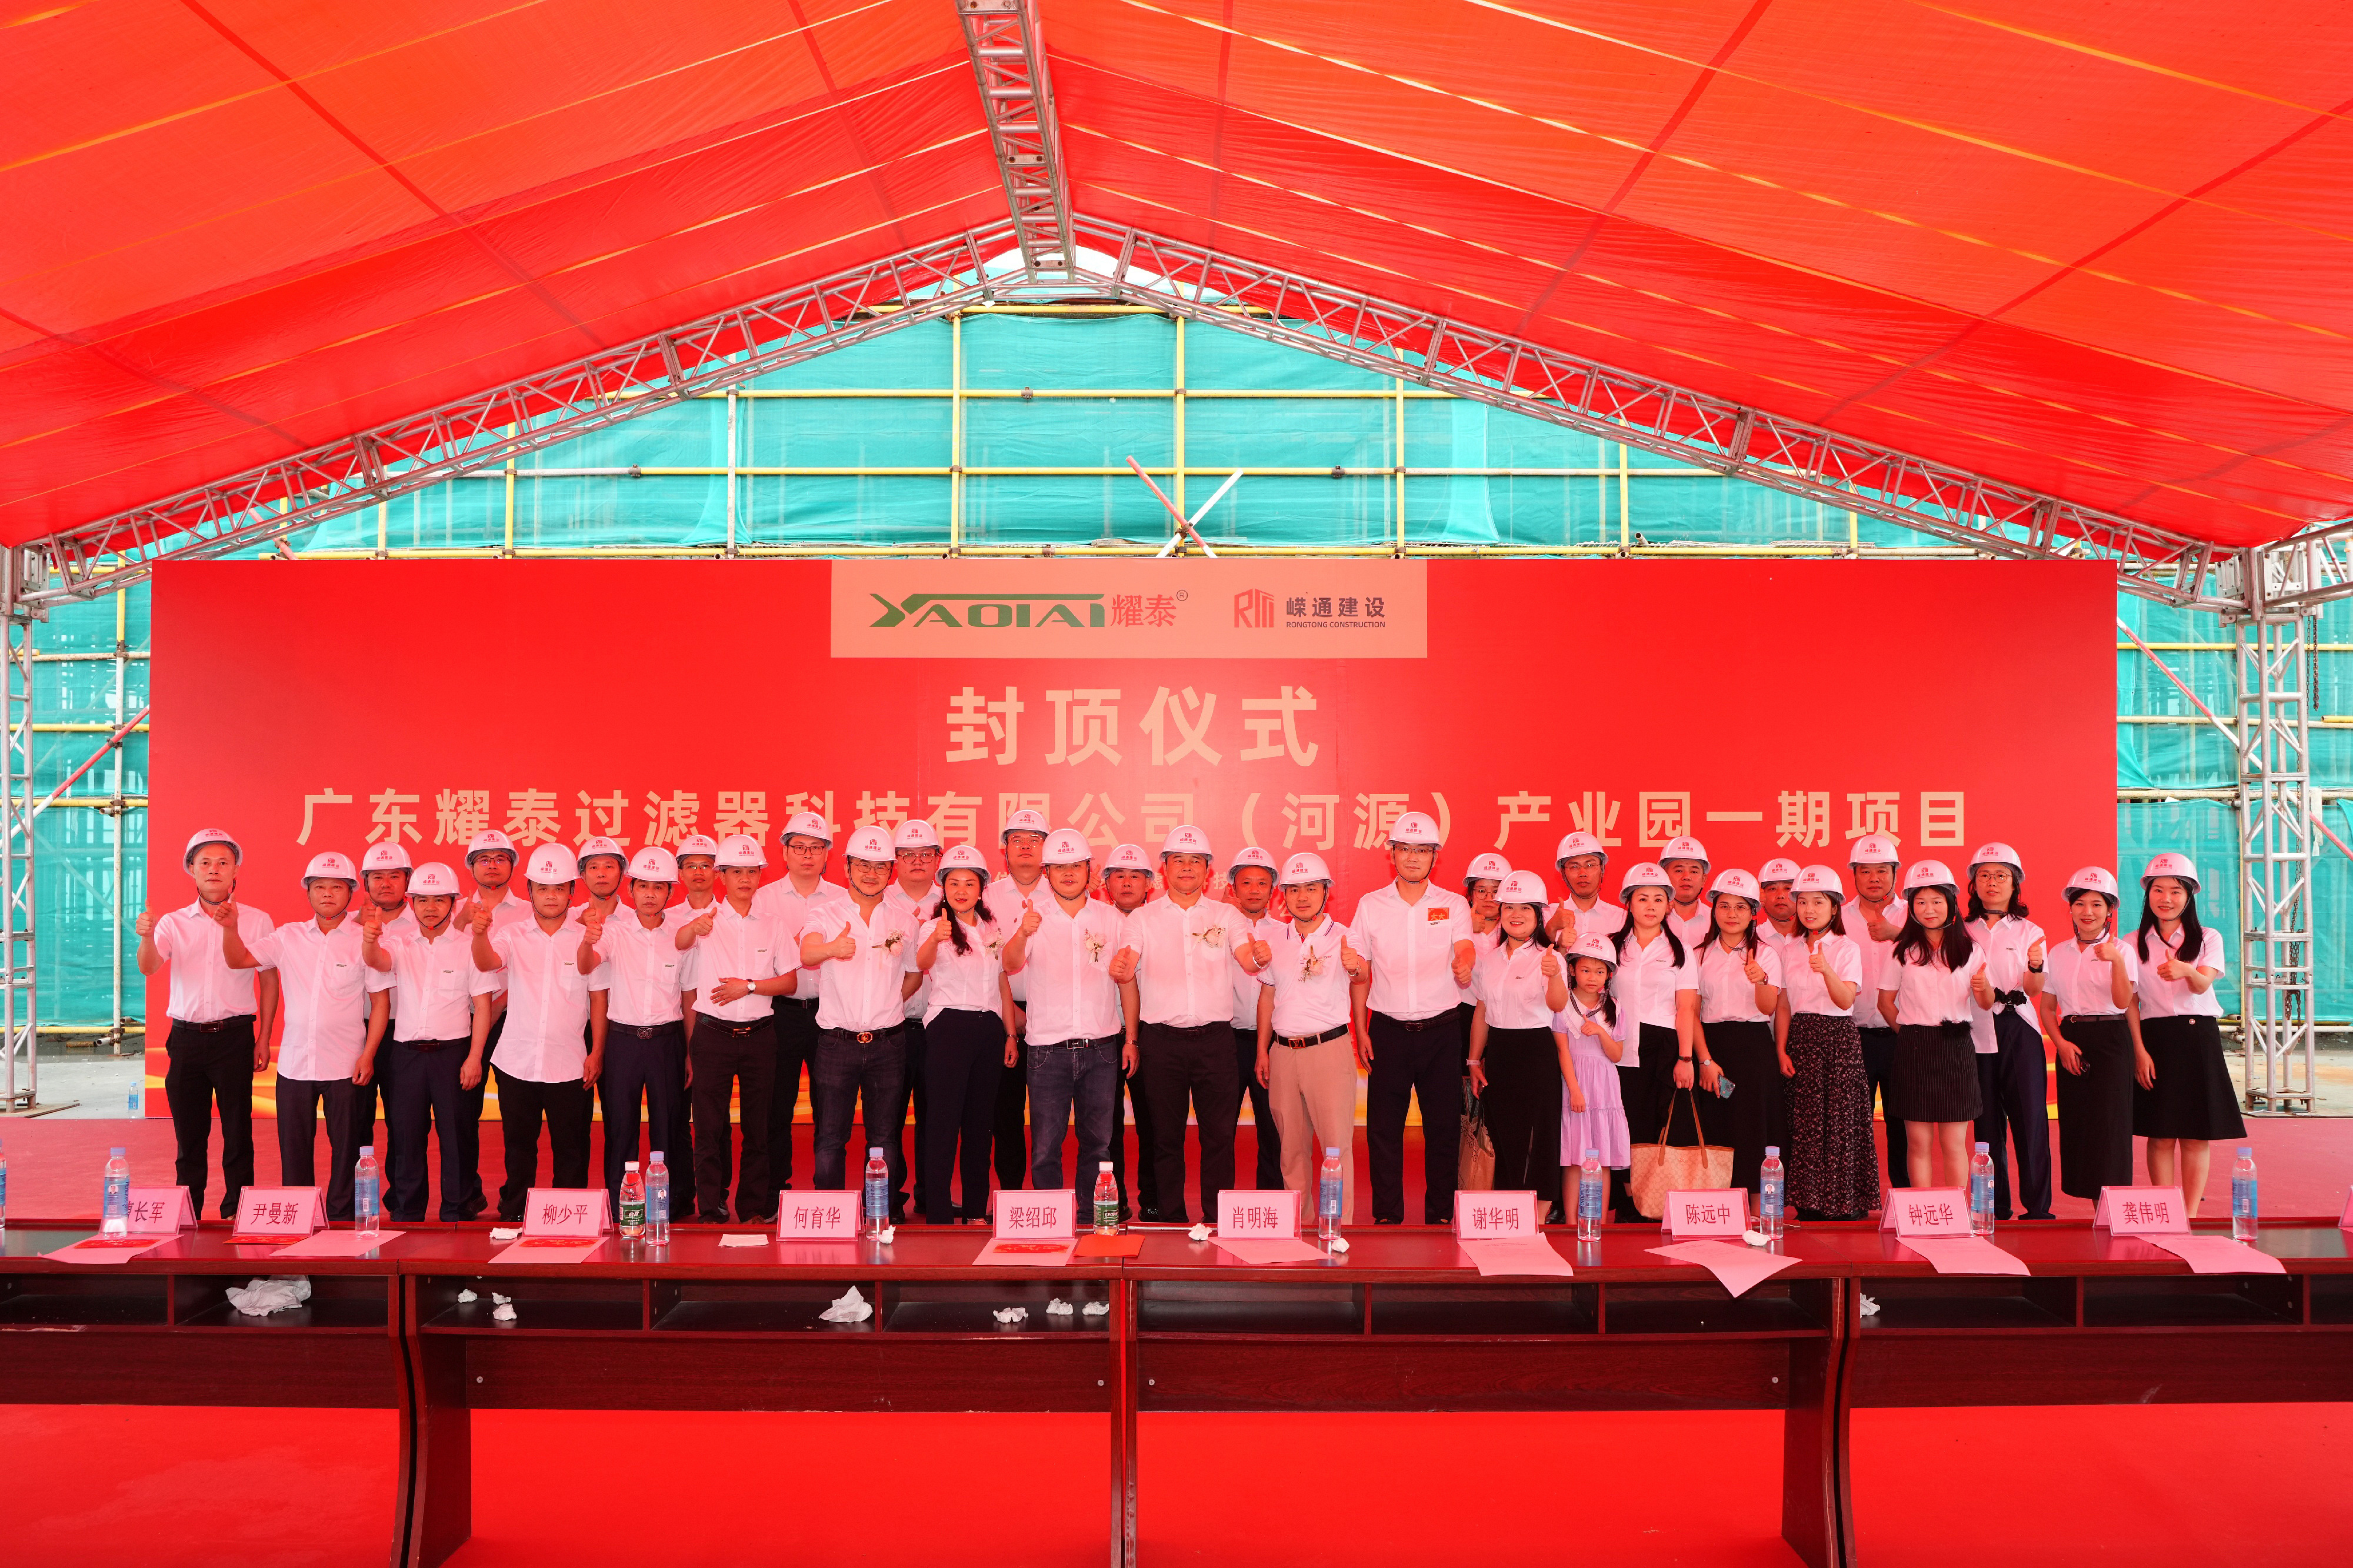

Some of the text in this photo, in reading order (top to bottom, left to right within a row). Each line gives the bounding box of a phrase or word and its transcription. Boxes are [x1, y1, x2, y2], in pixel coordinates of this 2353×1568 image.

[1287, 597, 1385, 618] 嵘通建设
[945, 686, 1318, 766] 封顶仪式
[251, 1202, 299, 1225] 尹曼新
[542, 1203, 588, 1225] 柳少平
[794, 1206, 841, 1229] 何育华
[1009, 1206, 1056, 1229] 梁绍邱
[1233, 1206, 1278, 1229] 肖明海
[1472, 1207, 1519, 1230] 谢华明
[1685, 1203, 1729, 1225] 陈远中
[1909, 1203, 1954, 1226] 钟远华
[2122, 1202, 2169, 1224] 龚伟明
